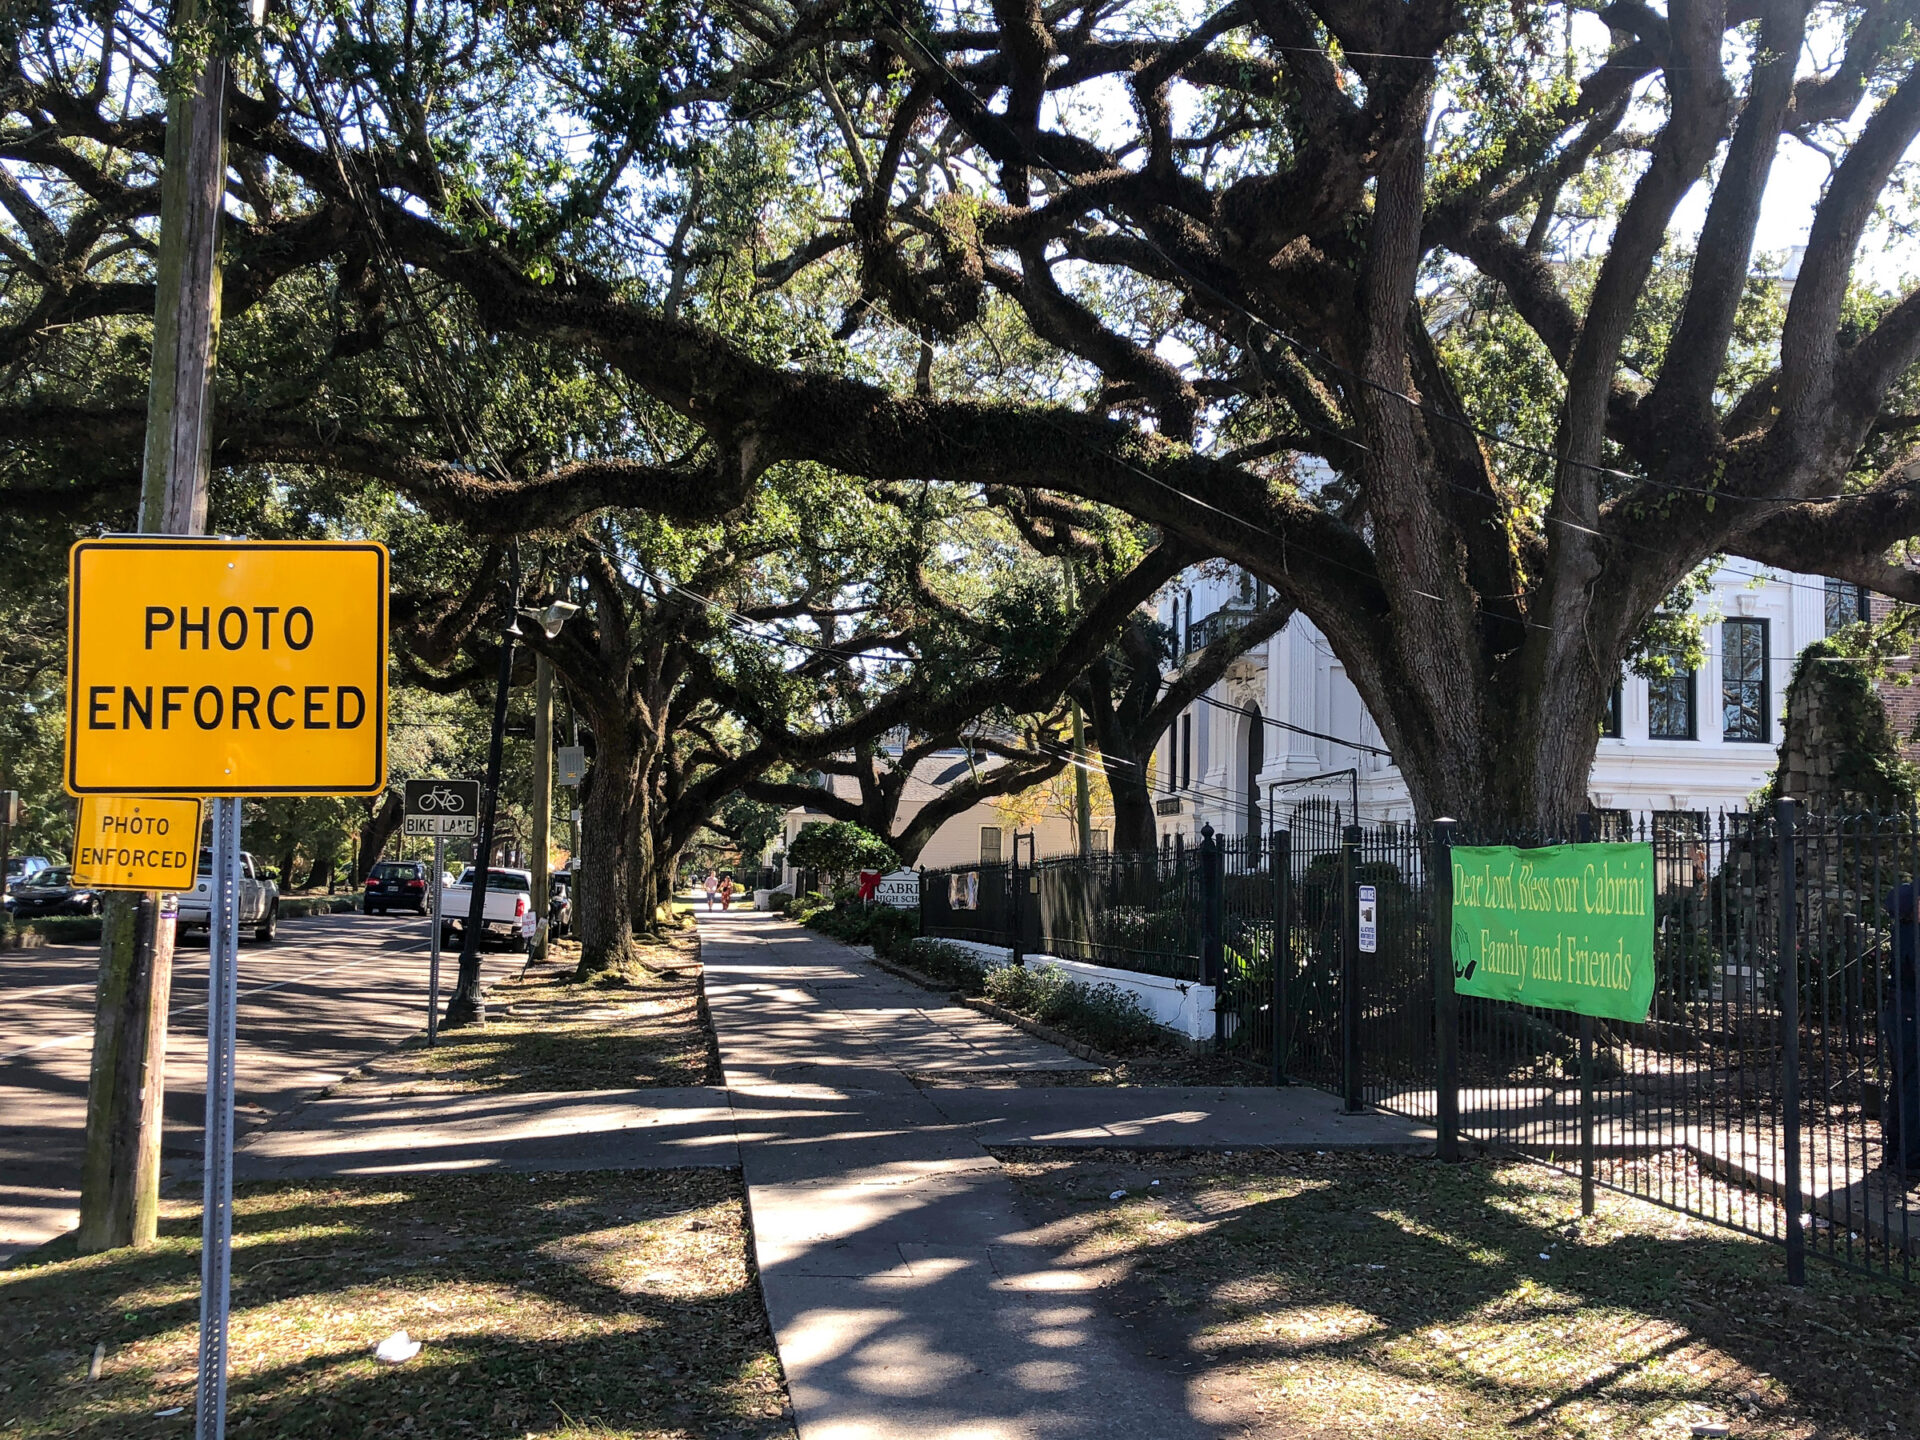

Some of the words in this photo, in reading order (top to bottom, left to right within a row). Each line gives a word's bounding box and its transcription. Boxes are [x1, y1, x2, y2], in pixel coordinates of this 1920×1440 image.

[145, 606, 314, 651] PHOTO
[88, 685, 366, 730] ENFORCED
[102, 816, 170, 835] PHOTO
[406, 819, 435, 832] BIKE
[442, 819, 474, 833] LANE
[80, 847, 187, 869] ENFORCED
[876, 895, 898, 903] HIGH
[901, 895, 919, 903] SCH
[1454, 863, 1484, 906] Dear
[1485, 861, 1517, 914] Lord,
[1518, 861, 1551, 913] Bless
[1553, 876, 1581, 914] our
[1583, 860, 1646, 916] Cabrini
[1480, 928, 1528, 991] Family
[1532, 931, 1563, 984] and
[1566, 935, 1632, 992] Friends
